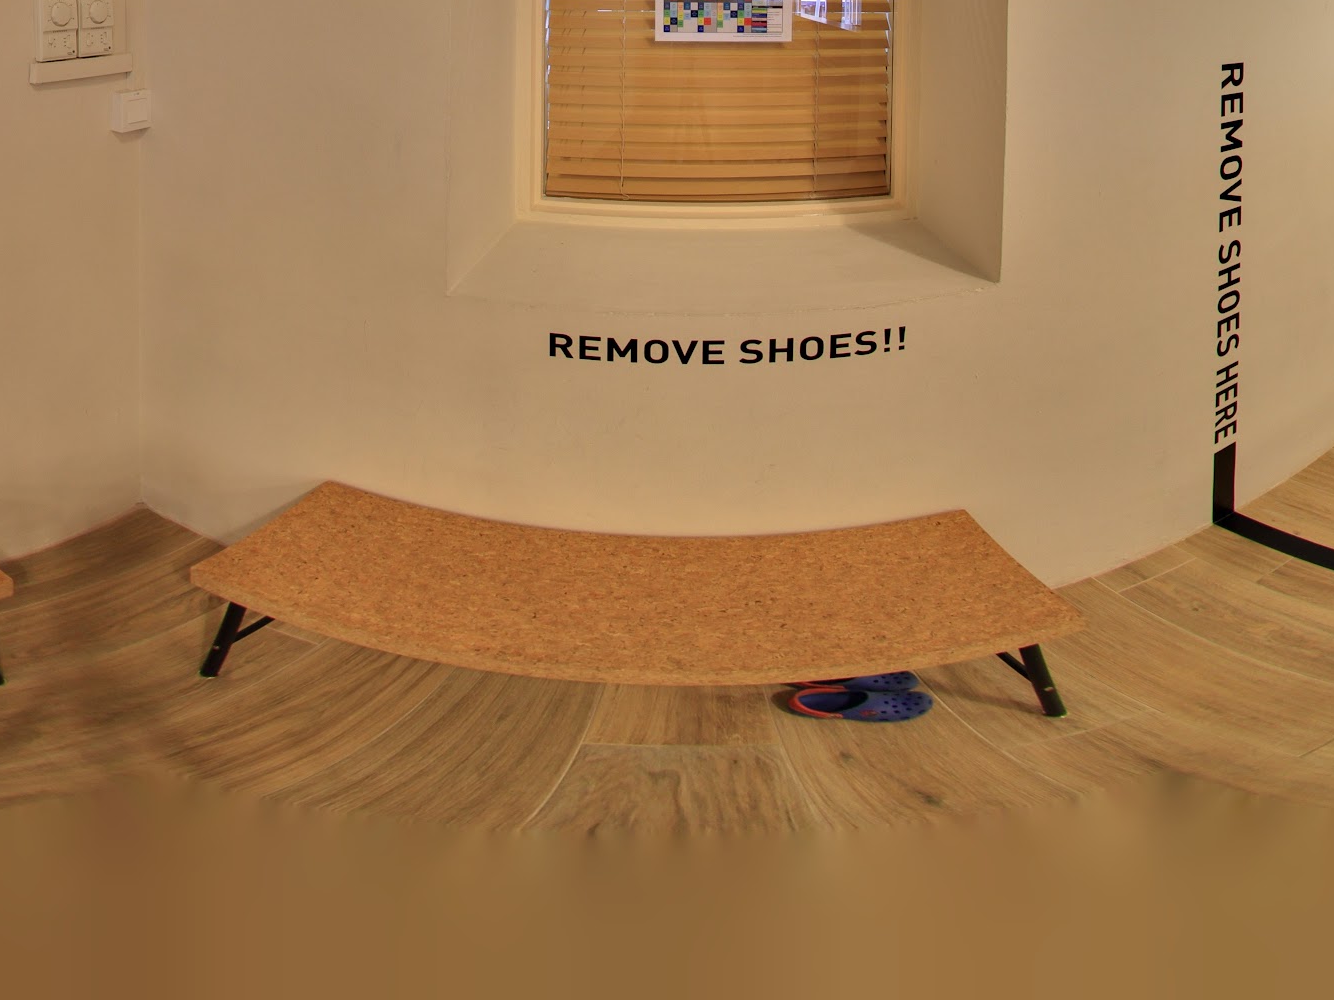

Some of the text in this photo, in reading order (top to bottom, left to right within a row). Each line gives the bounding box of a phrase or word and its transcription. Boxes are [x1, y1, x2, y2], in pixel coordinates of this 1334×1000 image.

[548, 325, 907, 365] REMOVE SHOES!!
[1213, 61, 1245, 445] REMOVE SHOES HERE
